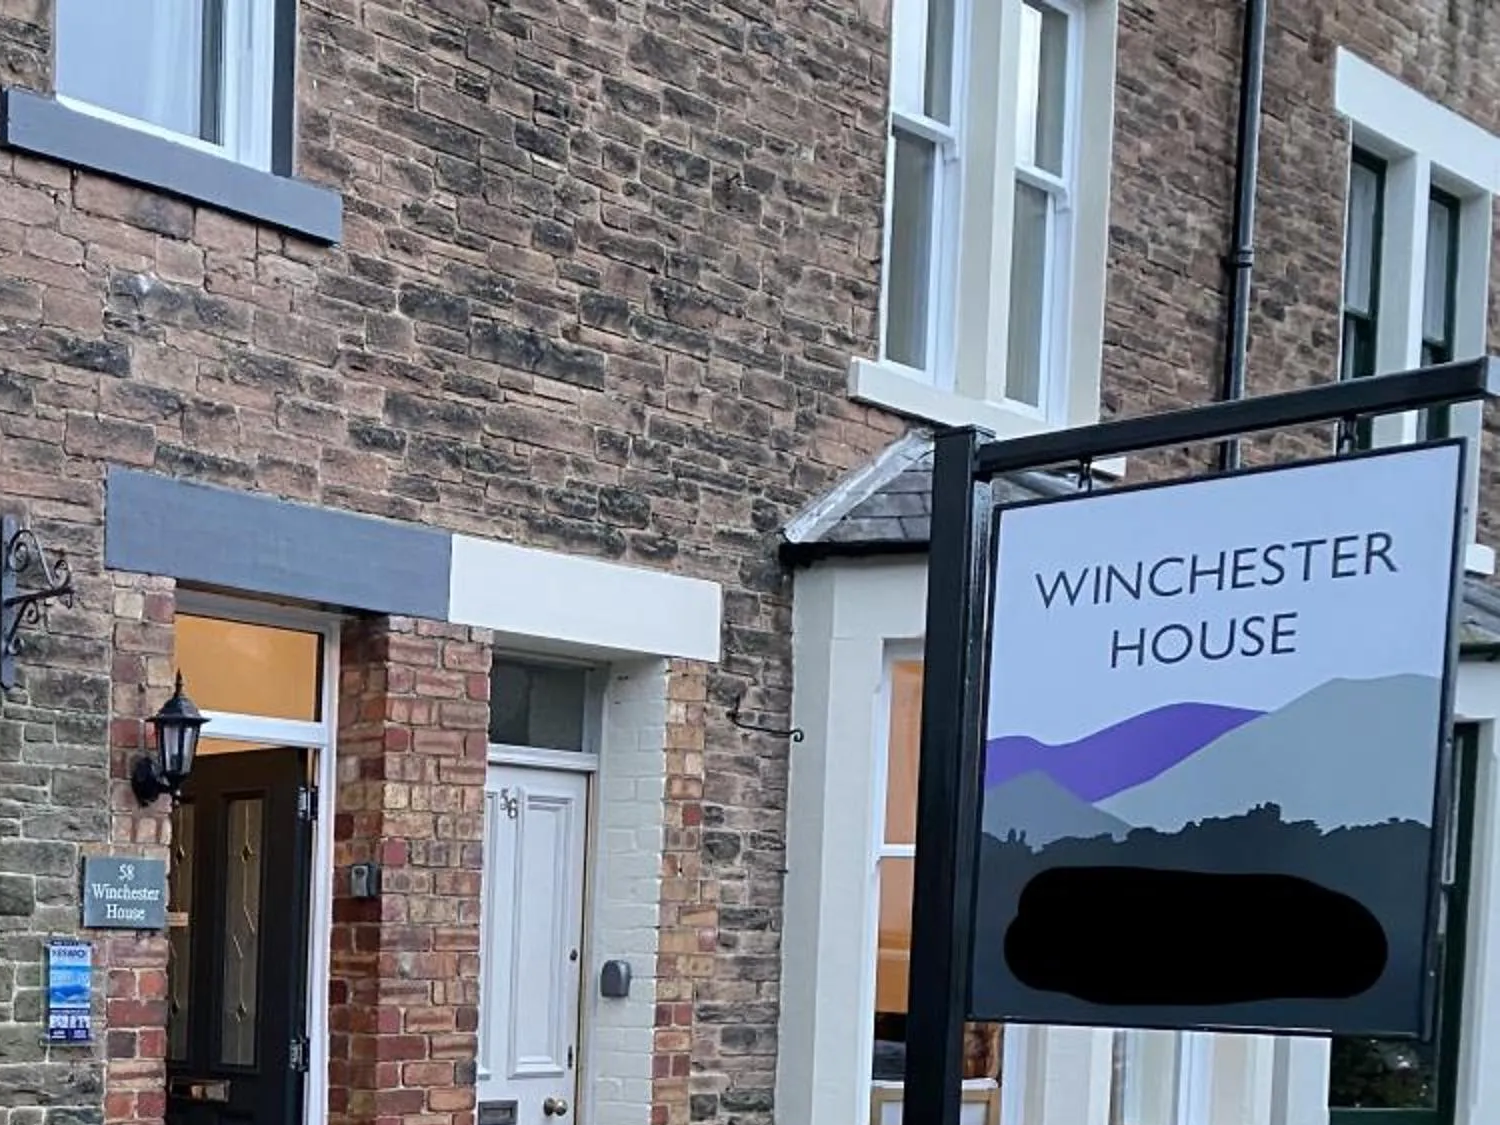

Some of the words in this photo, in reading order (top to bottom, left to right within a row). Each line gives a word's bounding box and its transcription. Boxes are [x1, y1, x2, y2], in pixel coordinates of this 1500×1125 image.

[1035, 530, 1399, 609] WINCHESTER
[1109, 611, 1298, 669] HOUSE
[118, 863, 135, 881] 58
[91, 882, 160, 901] Winchester
[105, 903, 146, 921] House
